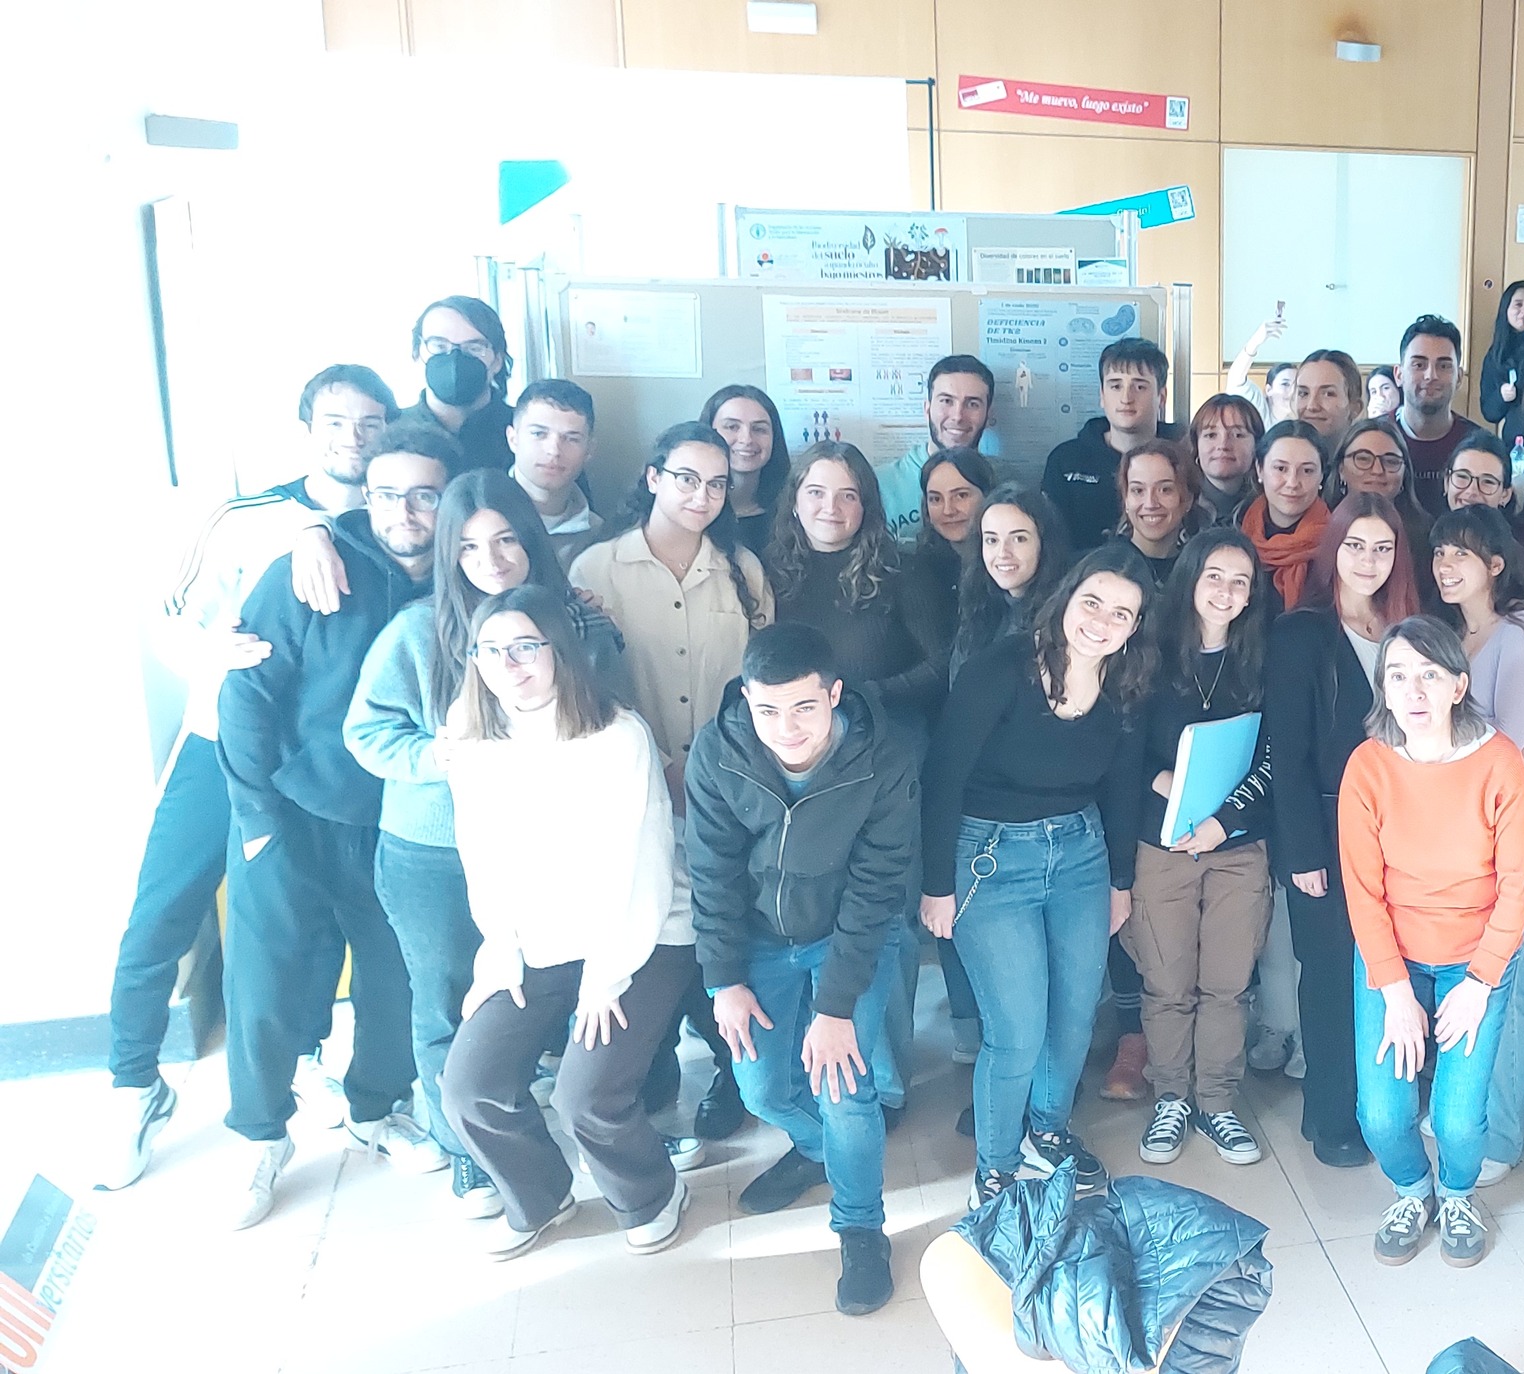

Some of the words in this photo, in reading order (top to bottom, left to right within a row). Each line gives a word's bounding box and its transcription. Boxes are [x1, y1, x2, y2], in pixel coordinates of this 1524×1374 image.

[1041, 95, 1079, 109] muevo,
[1081, 95, 1110, 114] luego
[824, 247, 856, 260] suelo
[986, 319, 1046, 327] DEFICIENCIA
[986, 327, 1000, 335] DE
